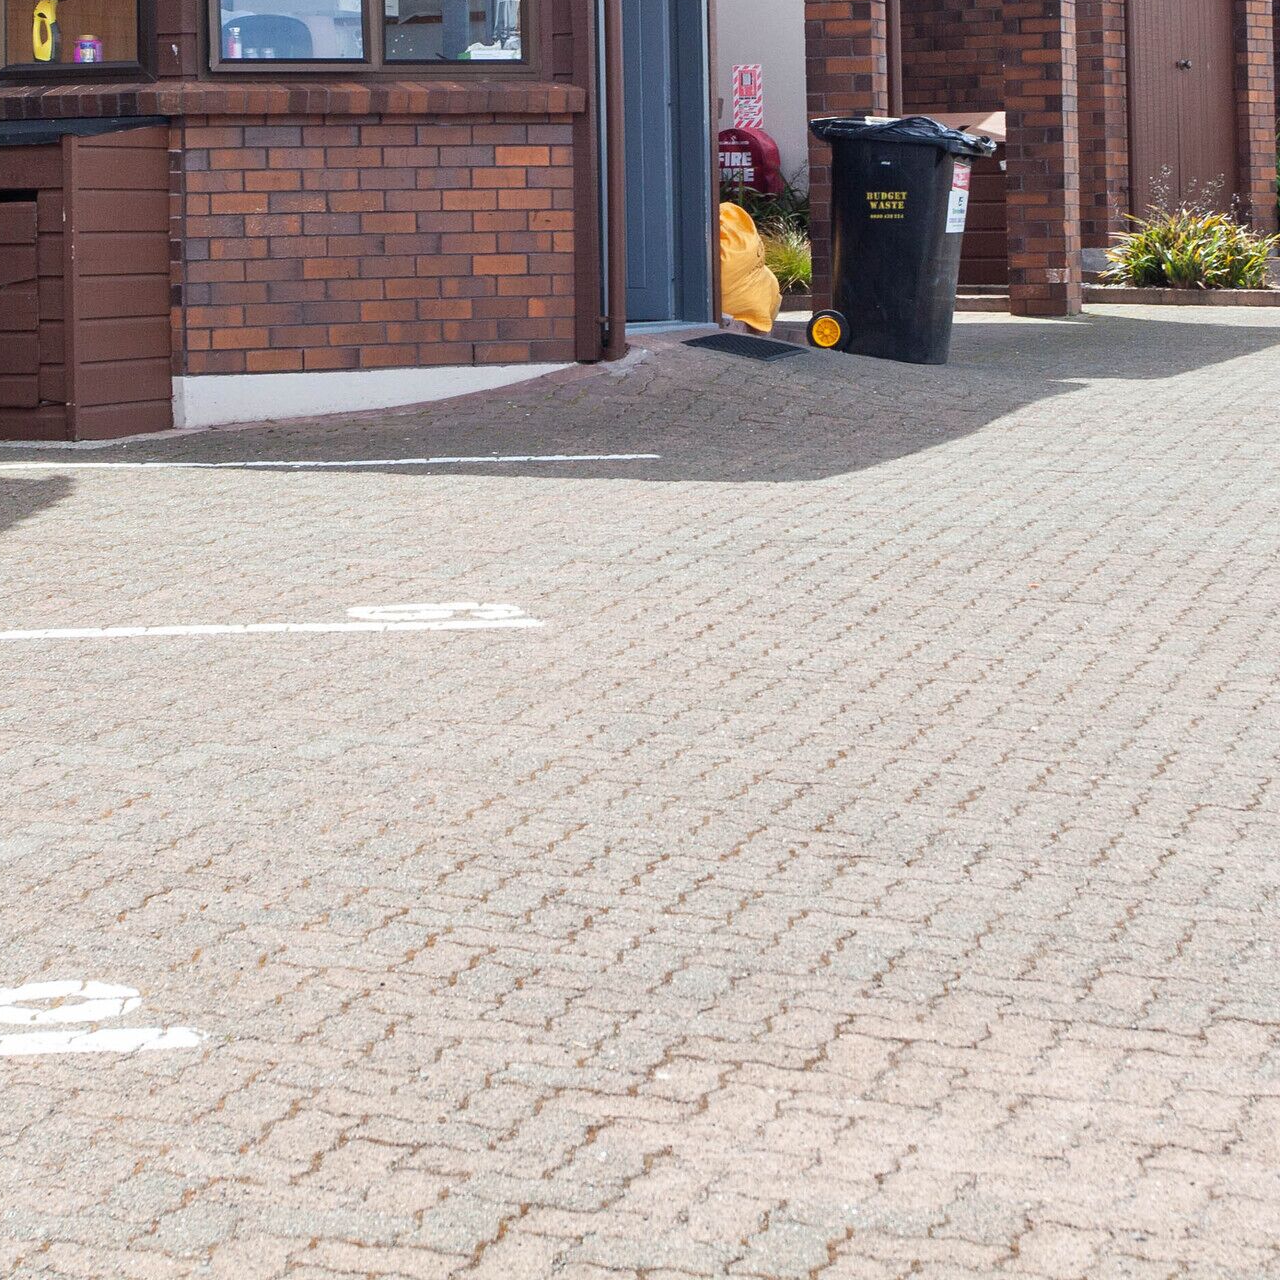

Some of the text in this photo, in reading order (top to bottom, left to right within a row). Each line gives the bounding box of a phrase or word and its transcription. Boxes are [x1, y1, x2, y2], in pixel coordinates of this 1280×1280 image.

[718, 152, 752, 166] FIRE
[866, 191, 907, 200] BUDGET
[870, 201, 904, 210] WASTE
